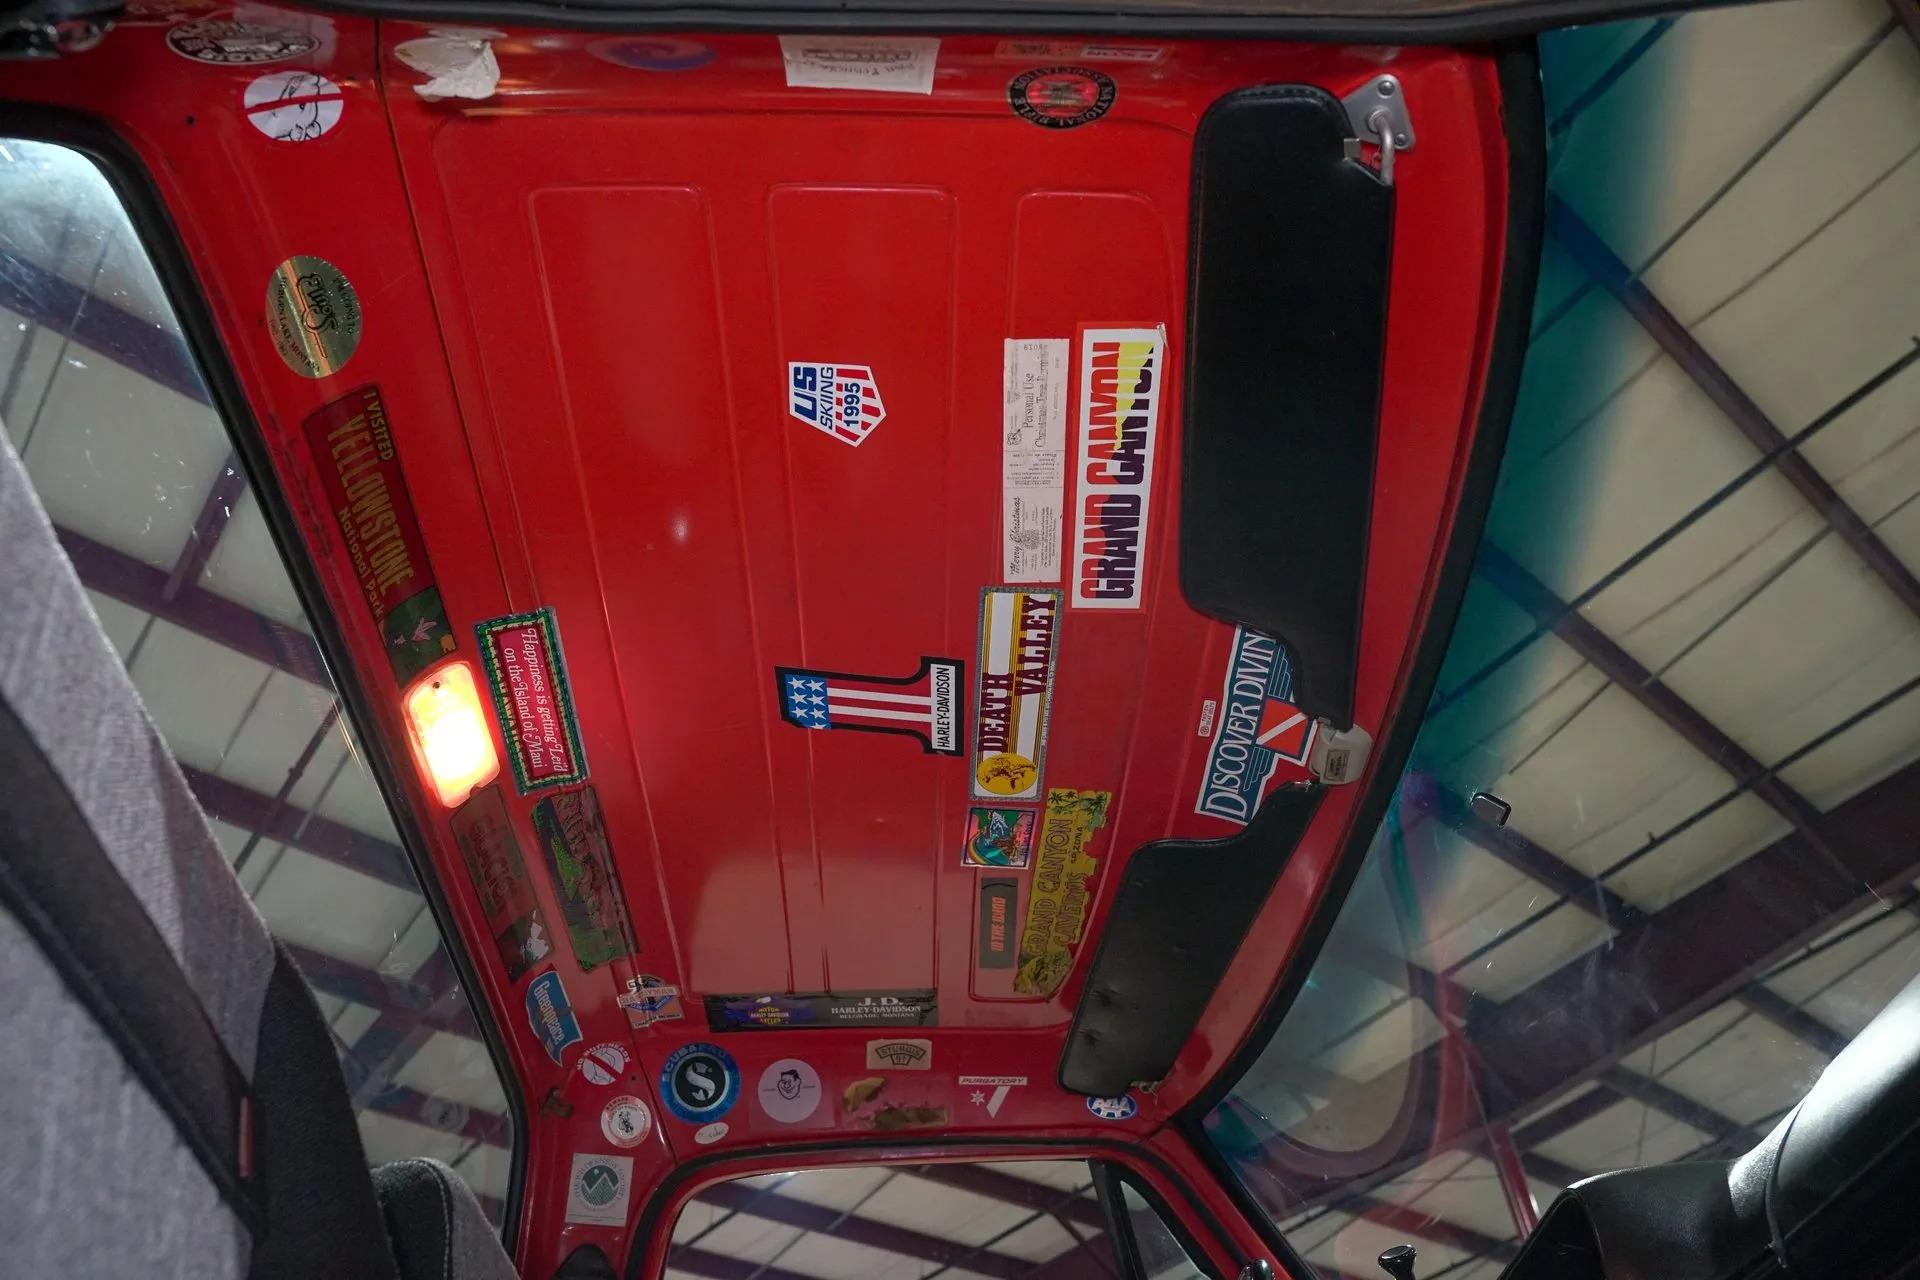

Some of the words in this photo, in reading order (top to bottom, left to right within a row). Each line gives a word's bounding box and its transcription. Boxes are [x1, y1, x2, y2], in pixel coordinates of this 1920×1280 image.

[1013, 96, 1049, 124] RIFLE
[1054, 86, 1113, 127] NATIONAL
[793, 367, 817, 421] US
[820, 367, 833, 430] SKIING
[1023, 373, 1035, 390] Use
[843, 383, 860, 427] 1995
[1021, 392, 1034, 428] Personal
[1086, 343, 1155, 484] CANYON
[364, 400, 395, 462] VISITED
[328, 413, 414, 596] YELLOWSTONE
[1009, 497, 1023, 543] Christmas
[338, 505, 371, 579] National
[365, 582, 385, 622] Park
[1010, 546, 1022, 575] Merry
[1080, 495, 1141, 599] GRAND
[503, 647, 516, 662] on
[521, 627, 545, 693] Happiness
[1014, 595, 1056, 696] VALLEY
[510, 664, 525, 683] the
[514, 680, 531, 720] Island
[536, 694, 547, 705] is
[936, 667, 951, 747] HARLEY-DAVIDSON
[977, 672, 1014, 753] DEATH
[1201, 703, 1210, 722] FASTEN
[523, 719, 538, 733] of
[537, 705, 559, 744] getting
[1206, 701, 1259, 817] DISCOVER
[1234, 628, 1277, 701] DIVIN
[522, 732, 547, 769] Maui
[1036, 817, 1073, 894] CANYON
[1024, 897, 1057, 955] GRAND
[1053, 871, 1088, 945] CAVERNS
[990, 922, 1006, 940] THE
[534, 979, 566, 1045] Greenpeace
[831, 1006, 921, 1015] HARLEY-DAVIDSON
[880, 1045, 922, 1056] STURGIS
